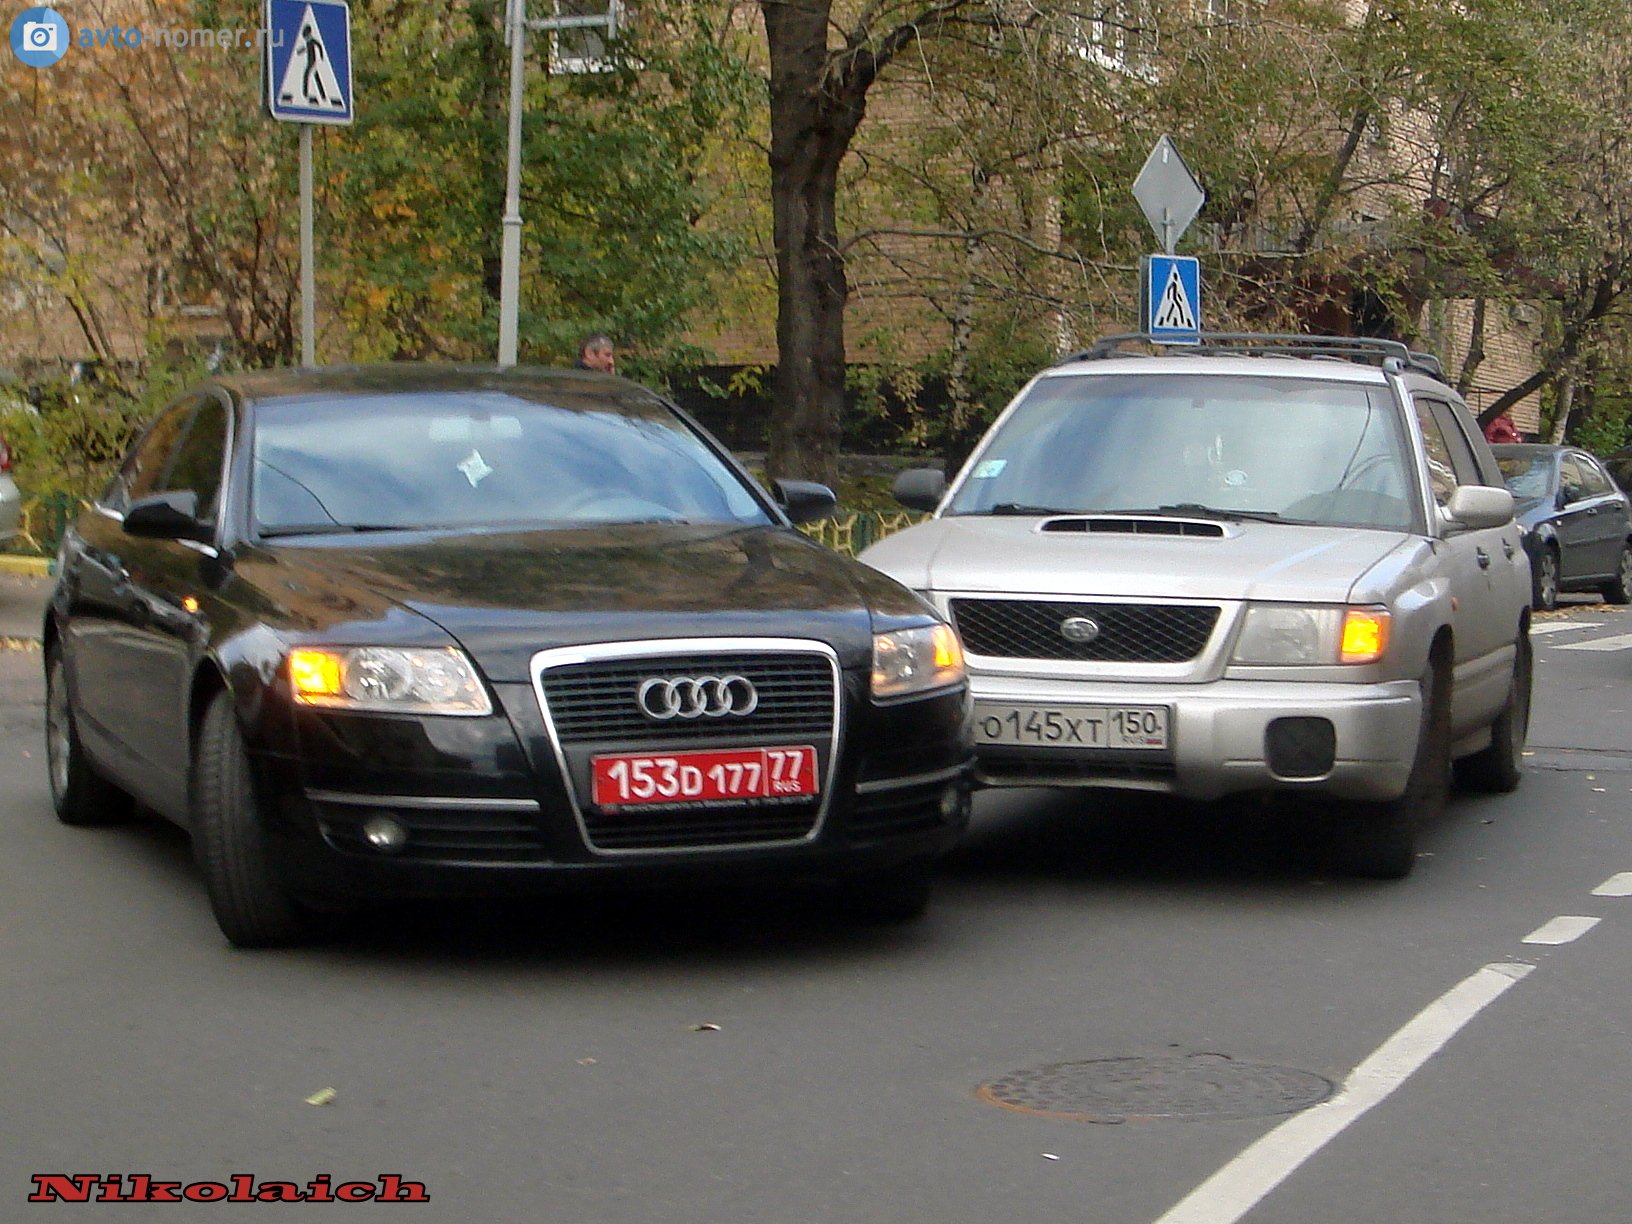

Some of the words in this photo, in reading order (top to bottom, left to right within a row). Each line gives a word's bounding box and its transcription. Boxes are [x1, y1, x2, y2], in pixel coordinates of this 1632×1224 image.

[1112, 710, 1157, 734] 150
[767, 750, 804, 780] 77
[772, 780, 802, 793] RUS
